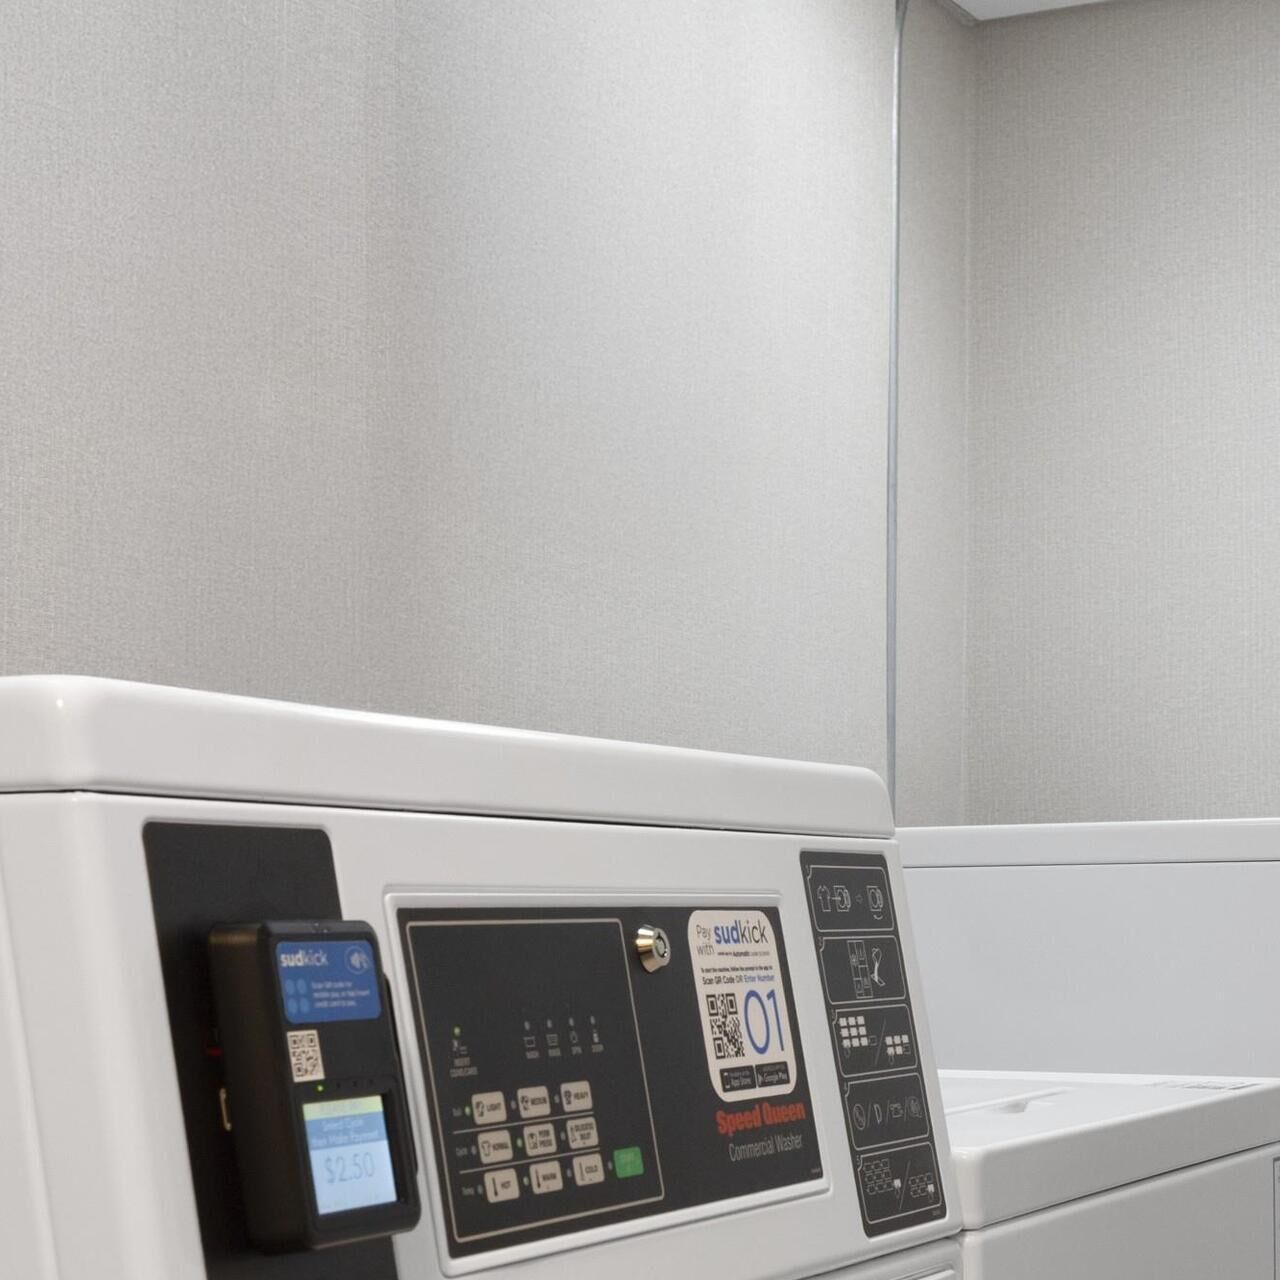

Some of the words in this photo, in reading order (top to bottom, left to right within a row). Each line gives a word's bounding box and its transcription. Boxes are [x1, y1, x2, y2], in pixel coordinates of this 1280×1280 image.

[696, 924, 712, 941] Pay
[713, 920, 769, 945] sudkick
[280, 949, 328, 968] sudkick
[696, 944, 715, 957] with
[744, 988, 785, 1055] 01
[486, 1102, 502, 1112] LIGHT
[715, 1104, 762, 1136] Speed
[763, 1102, 807, 1125] Queen
[729, 1137, 775, 1162] Commercial
[775, 1133, 803, 1153] Washer
[324, 1152, 376, 1184] $2.50
[500, 1180, 511, 1190] HOT
